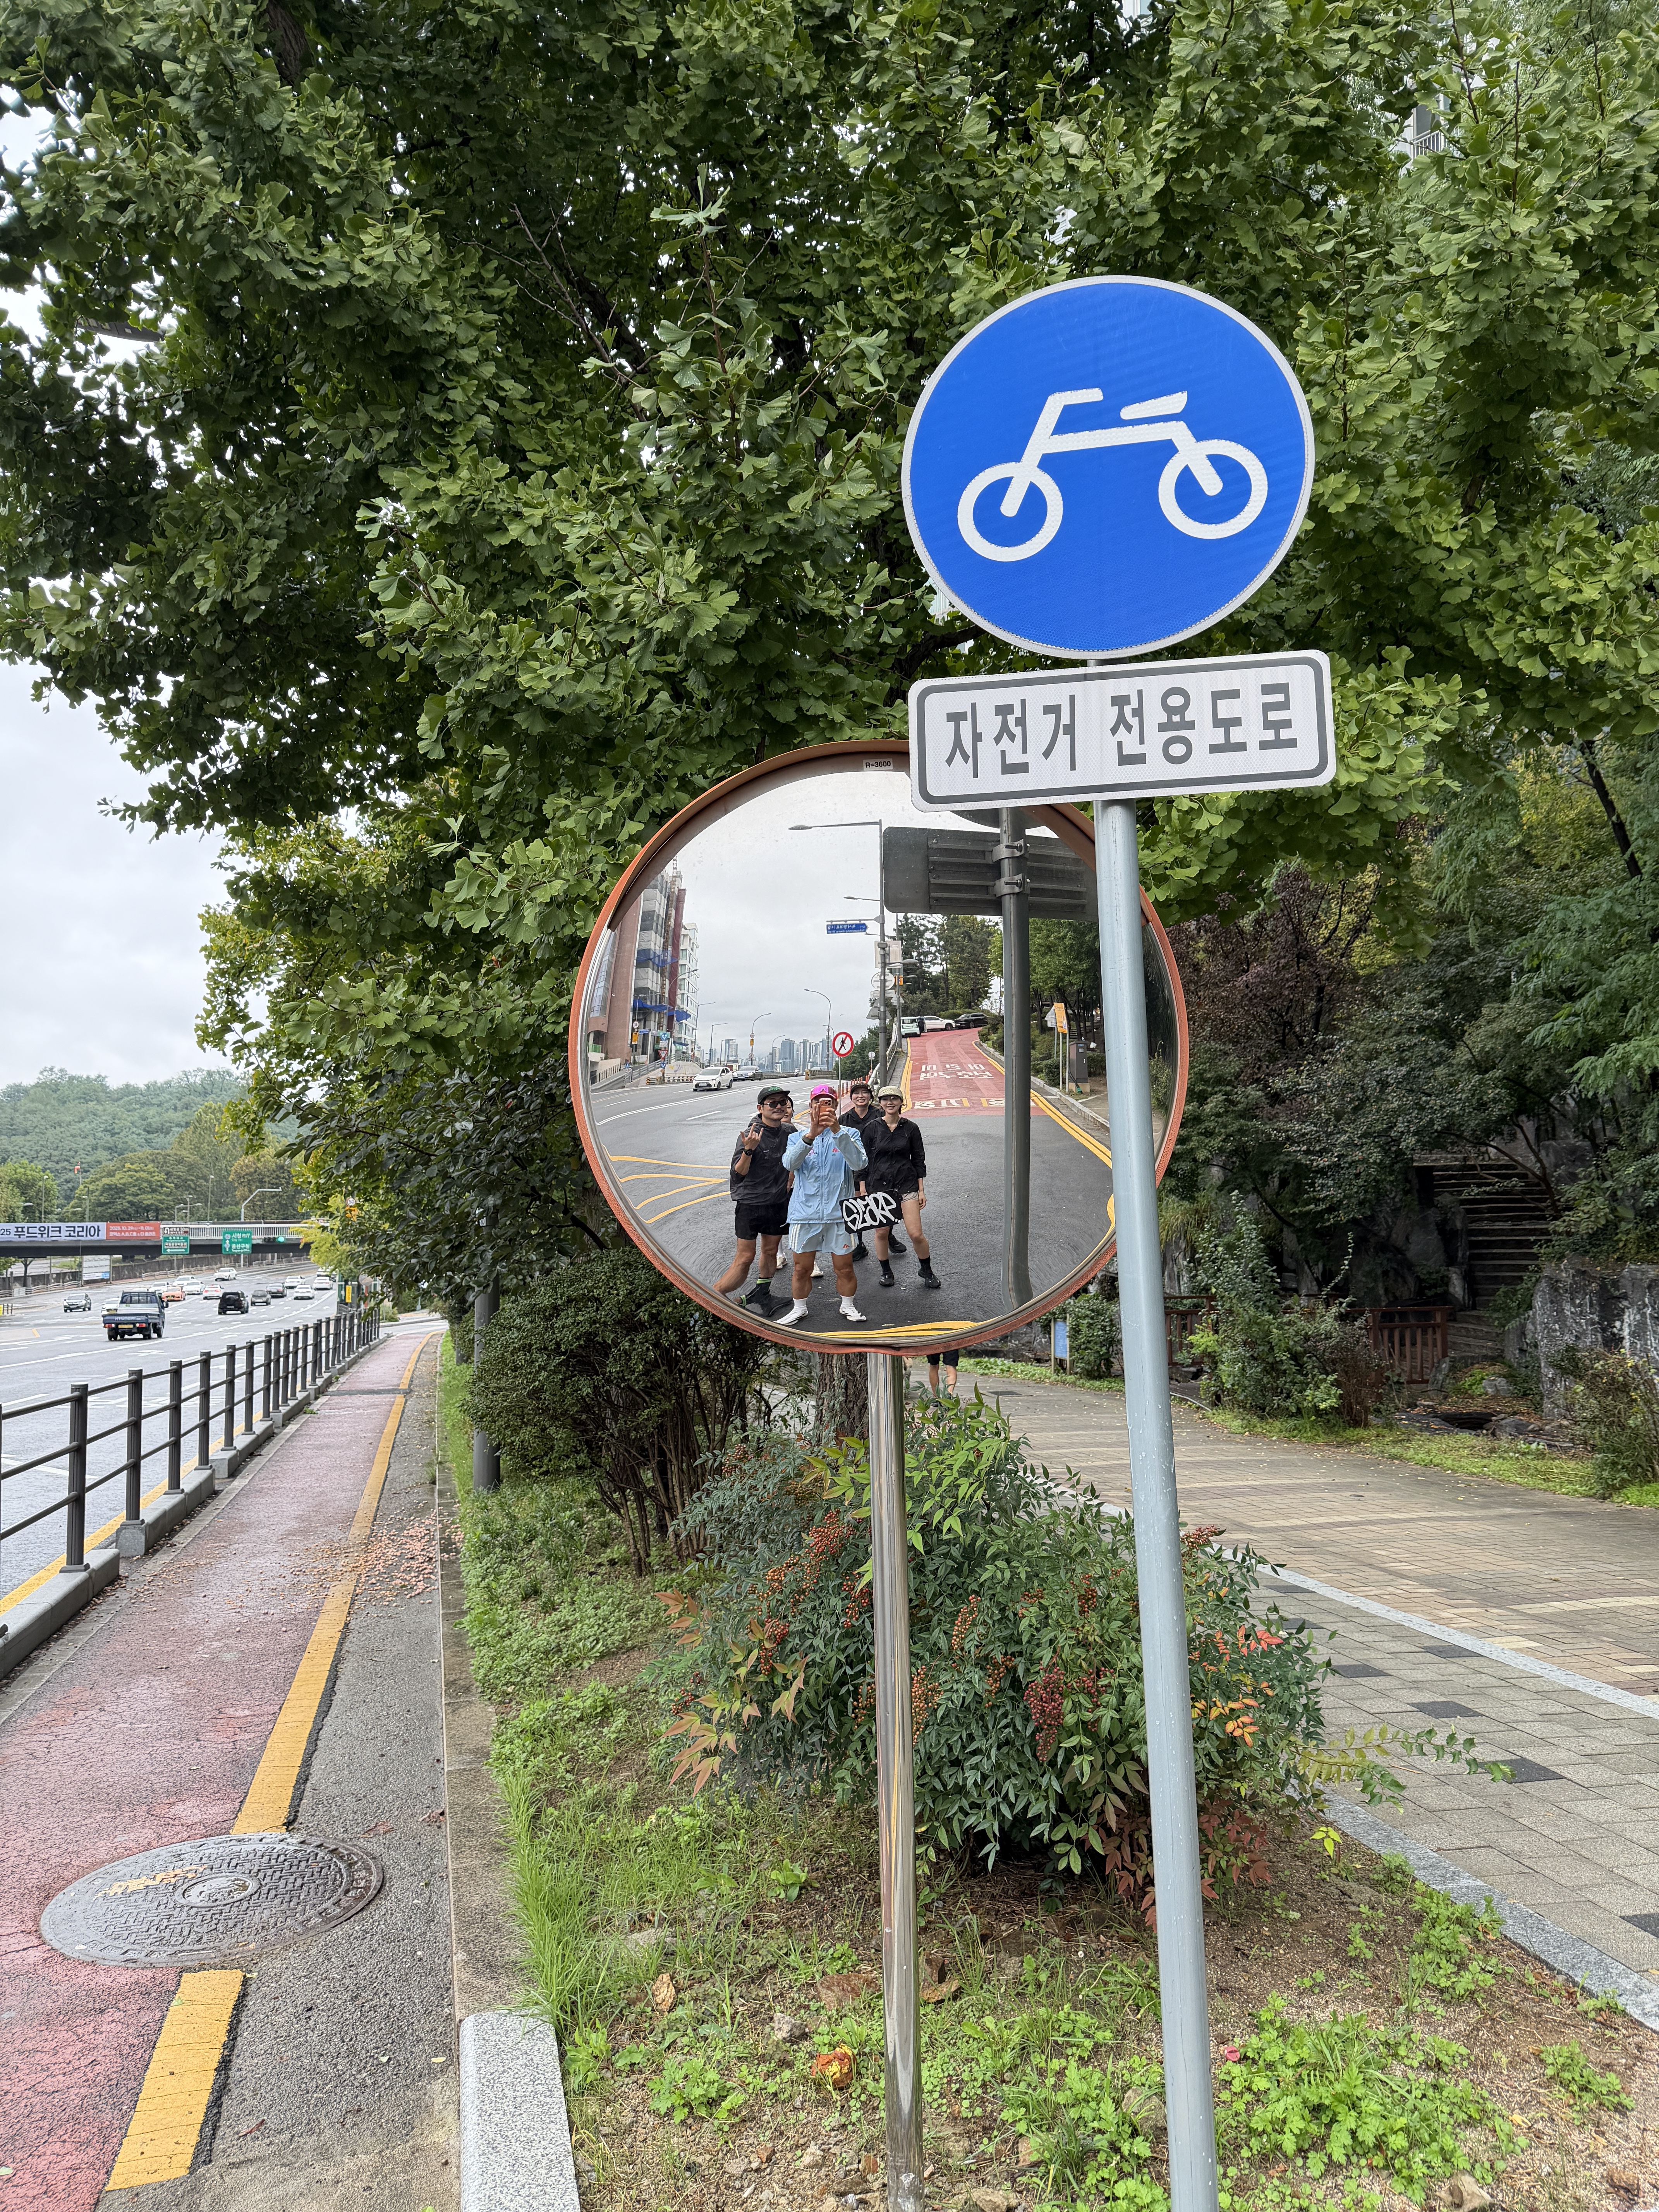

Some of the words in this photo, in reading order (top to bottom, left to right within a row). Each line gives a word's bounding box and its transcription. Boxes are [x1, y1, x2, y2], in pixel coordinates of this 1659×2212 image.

[945, 694, 1077, 779] 자전거
[1109, 682, 1298, 766] 전용도로
[14, 1226, 62, 1238] 푸드위크
[64, 1225, 101, 1238] 코리아
